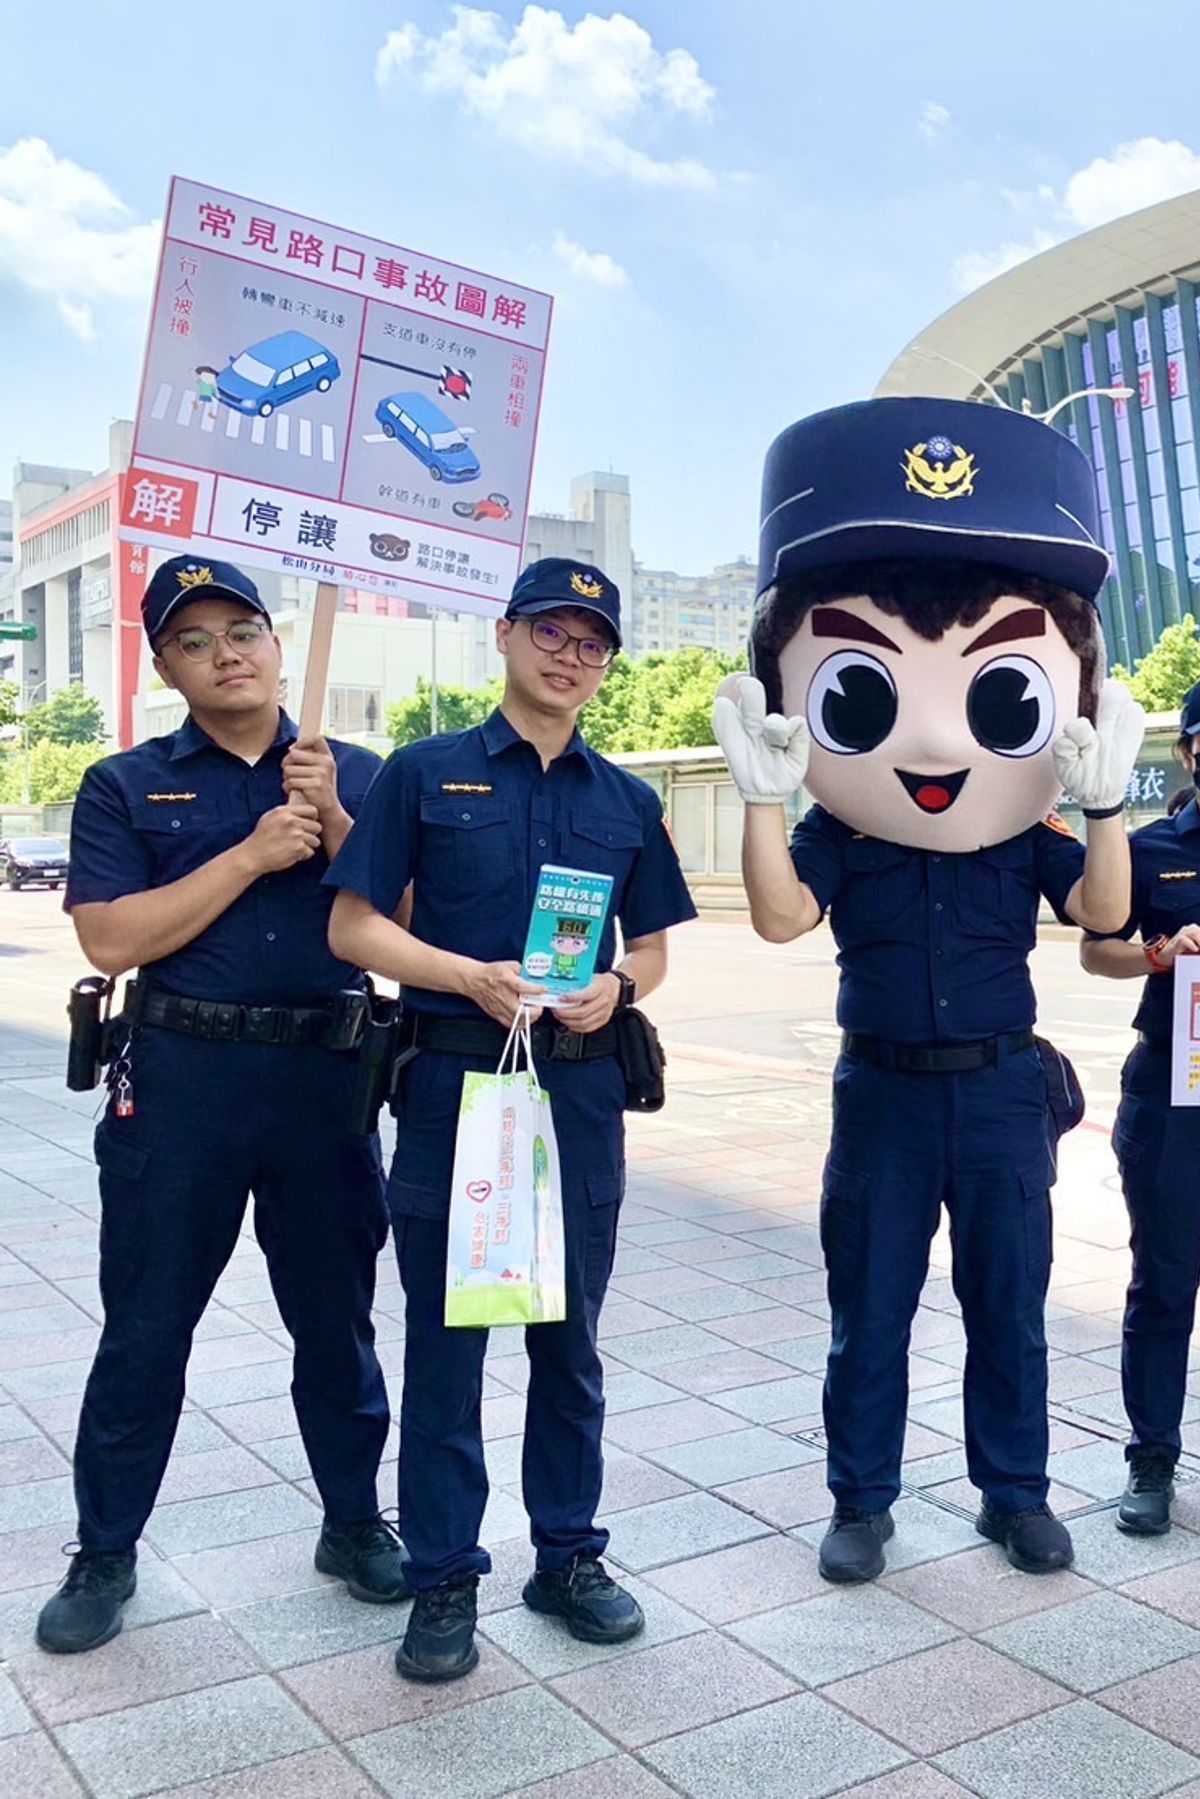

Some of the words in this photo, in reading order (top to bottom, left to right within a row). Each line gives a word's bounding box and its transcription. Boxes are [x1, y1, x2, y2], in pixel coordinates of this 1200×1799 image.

[198, 202, 528, 331] 常見路口事故圖解
[169, 255, 198, 337] 行人被撞
[382, 321, 478, 361] 支道車沒有停
[505, 353, 530, 428] 兩車相撞
[129, 478, 184, 528] 解
[242, 497, 339, 553] 停讓
[416, 556, 499, 585] 解決事故發生!
[417, 543, 470, 565] 路口停讓
